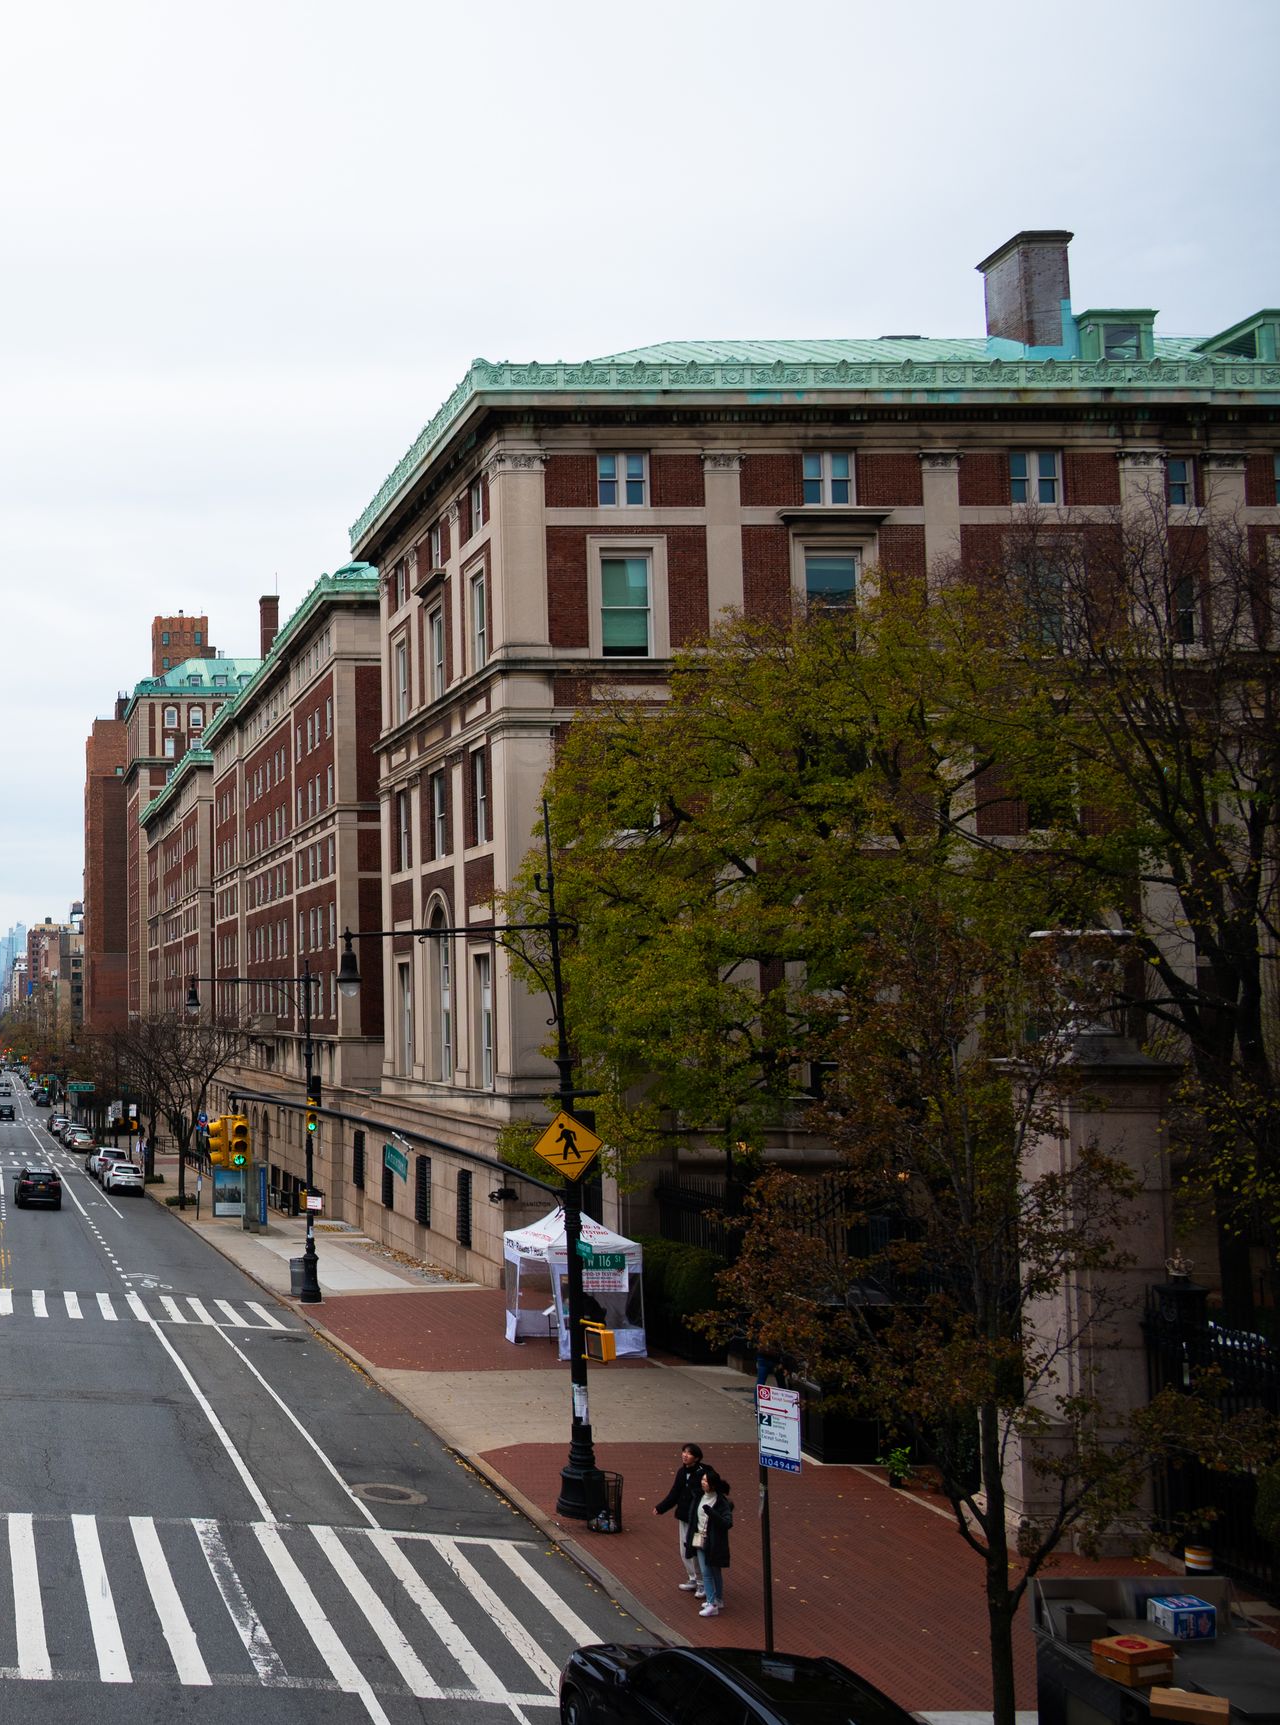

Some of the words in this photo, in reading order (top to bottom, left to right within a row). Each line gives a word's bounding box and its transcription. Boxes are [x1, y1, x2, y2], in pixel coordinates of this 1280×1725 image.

[588, 1256, 594, 1266] W
[599, 1256, 611, 1268] 116
[762, 1414, 769, 1424] 2
[761, 1456, 790, 1470] 110494
